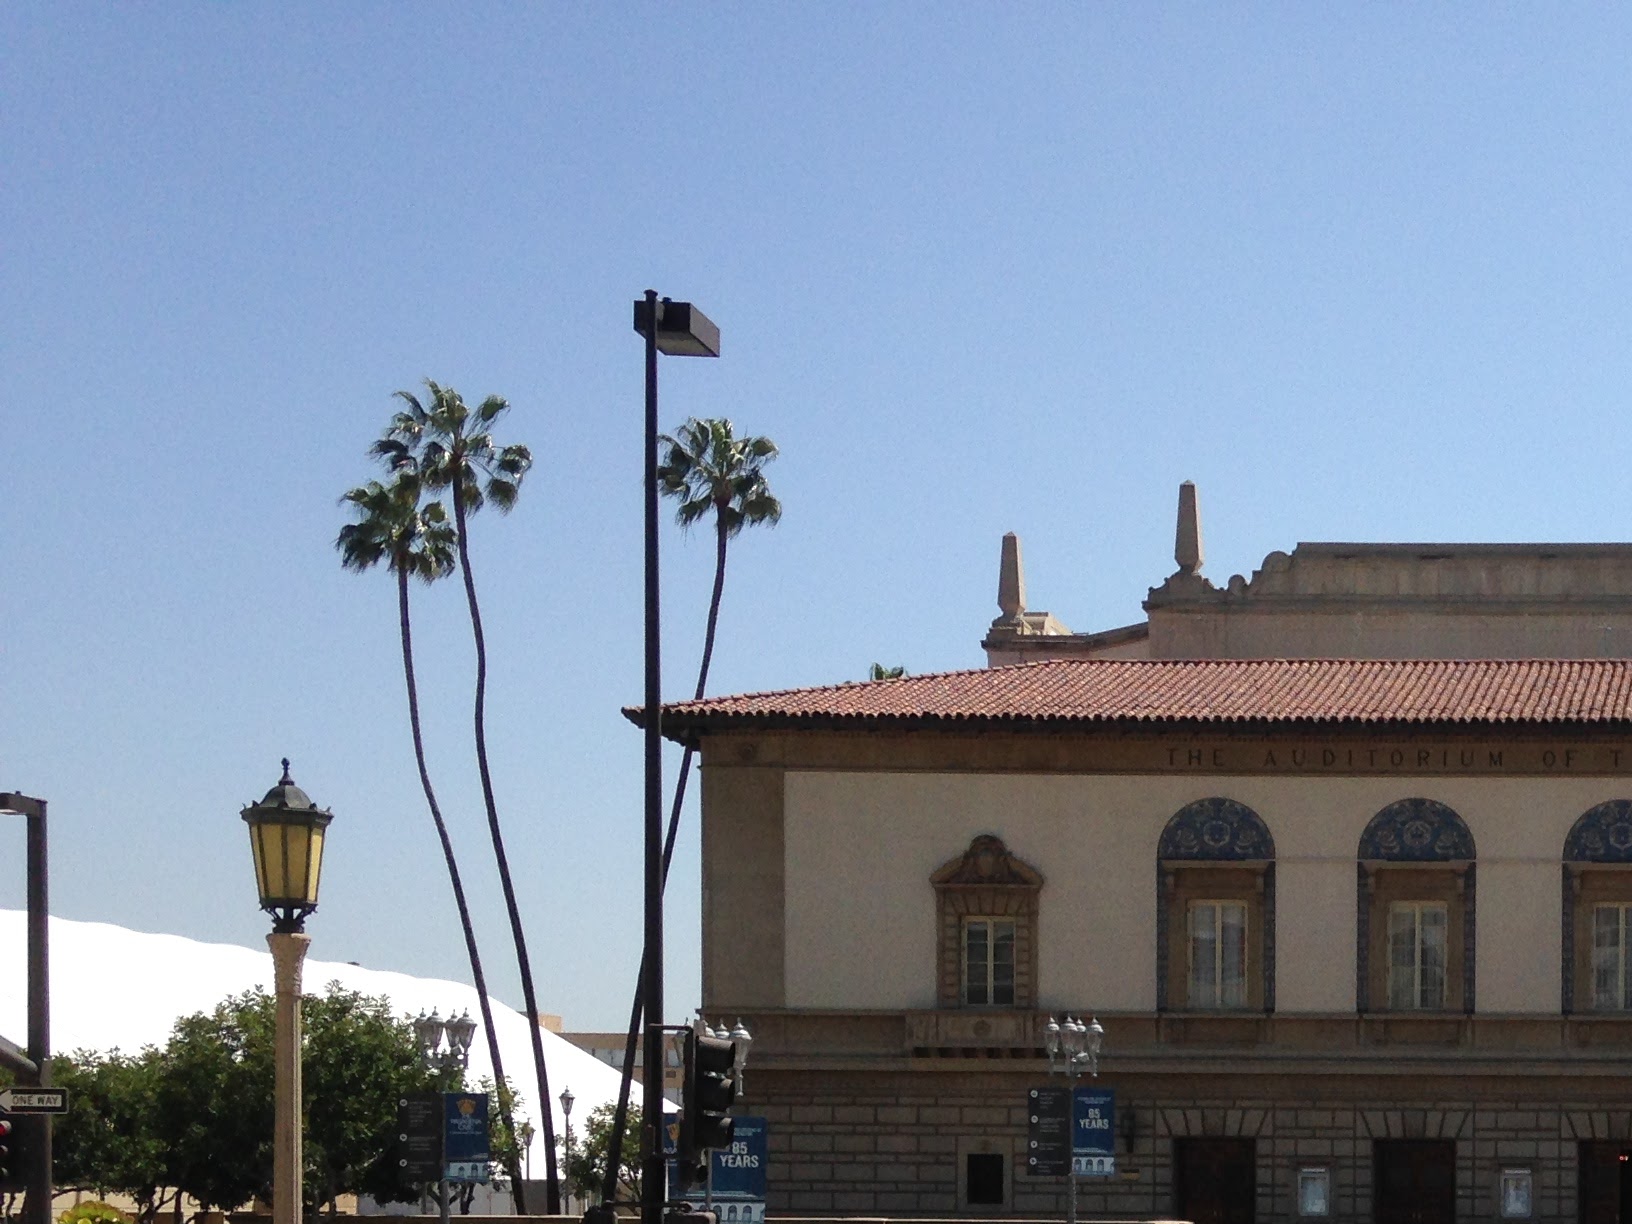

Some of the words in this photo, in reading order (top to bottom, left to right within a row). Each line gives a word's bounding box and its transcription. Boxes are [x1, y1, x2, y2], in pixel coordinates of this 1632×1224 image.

[1166, 748, 1225, 767] THE
[1263, 749, 1503, 768] AUDITORIUM
[1542, 749, 1579, 768] OF
[12, 1095, 34, 1106] ONE
[37, 1095, 58, 1106] WAY
[1079, 1118, 1110, 1130] YEARS
[732, 1141, 749, 1155] 85
[720, 1155, 760, 1168] YEARS
